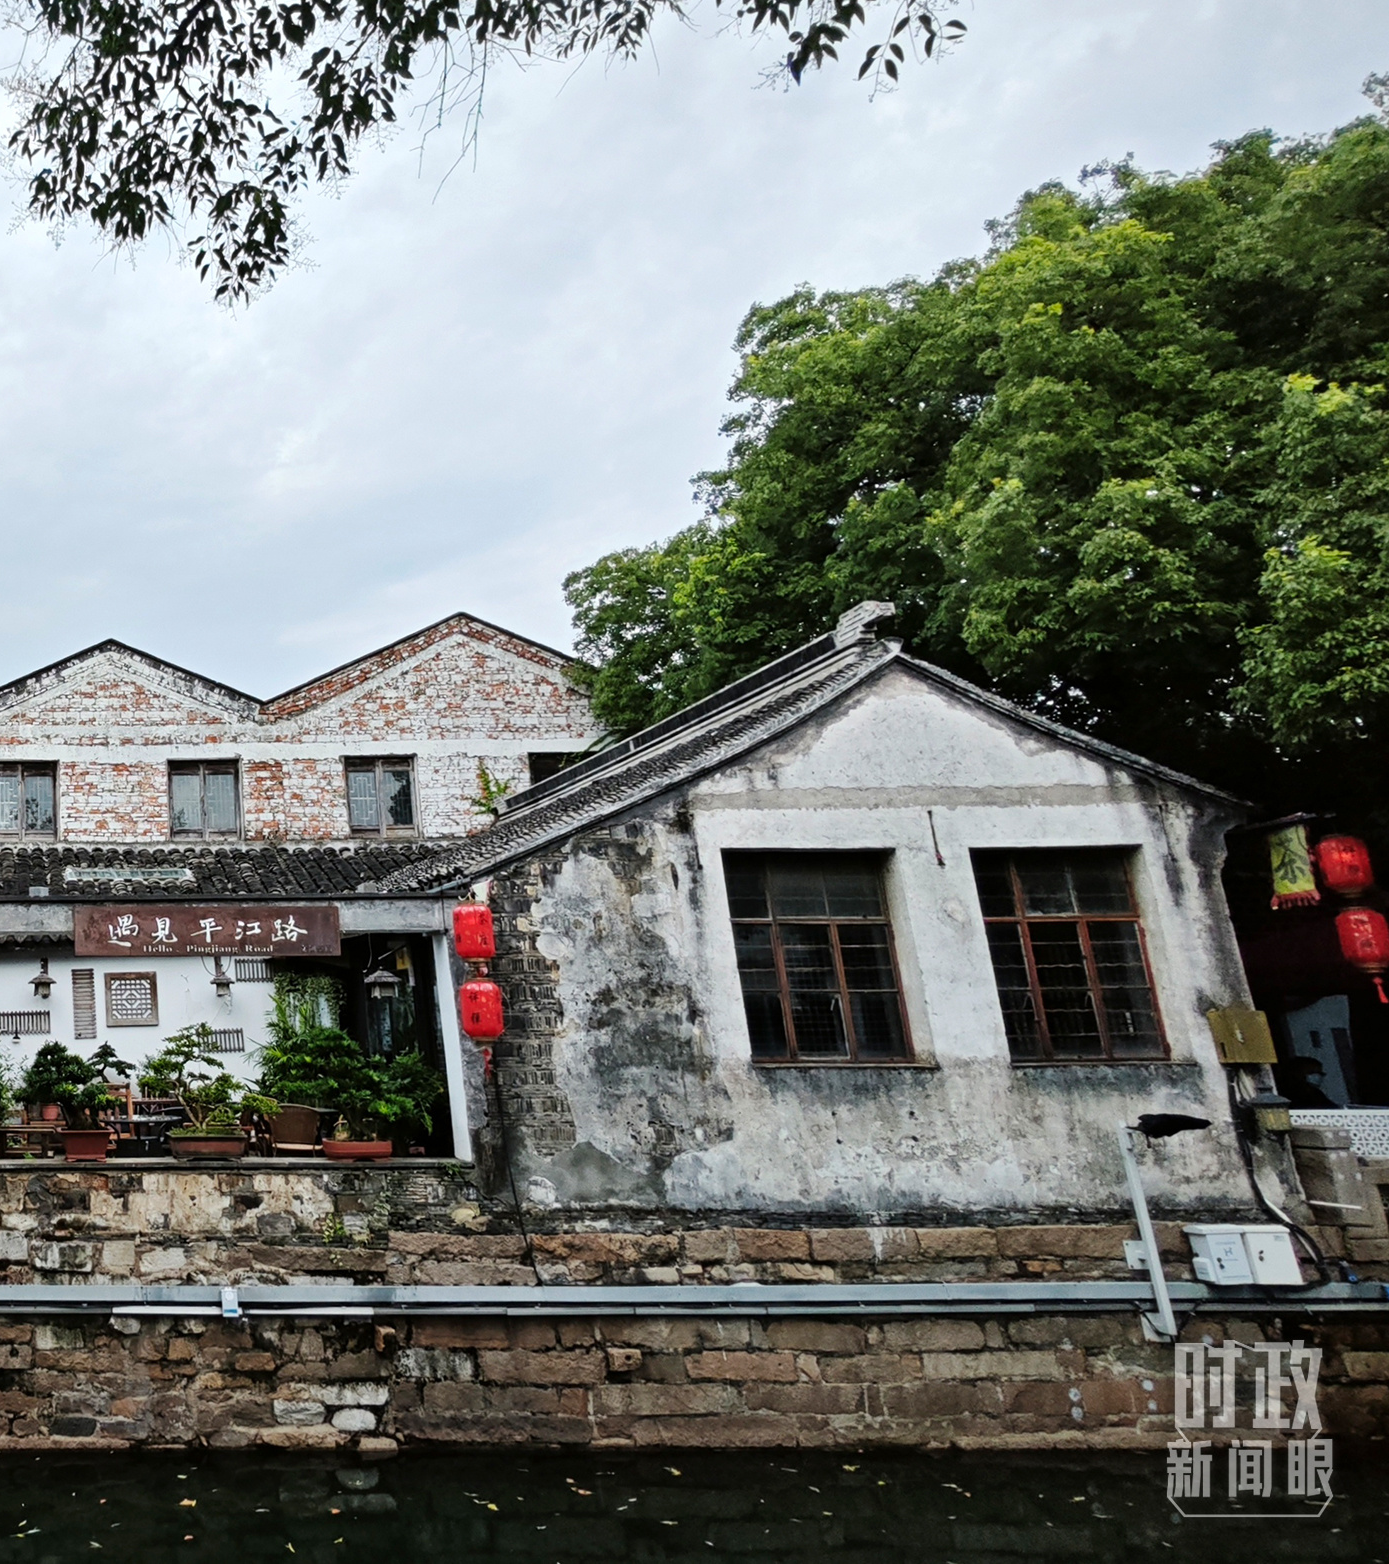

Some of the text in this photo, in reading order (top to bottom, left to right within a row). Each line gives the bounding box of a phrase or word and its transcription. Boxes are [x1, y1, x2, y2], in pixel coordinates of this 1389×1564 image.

[1276, 835, 1310, 884] 茶
[186, 944, 239, 954] Pingjiang
[245, 944, 274, 953] Road
